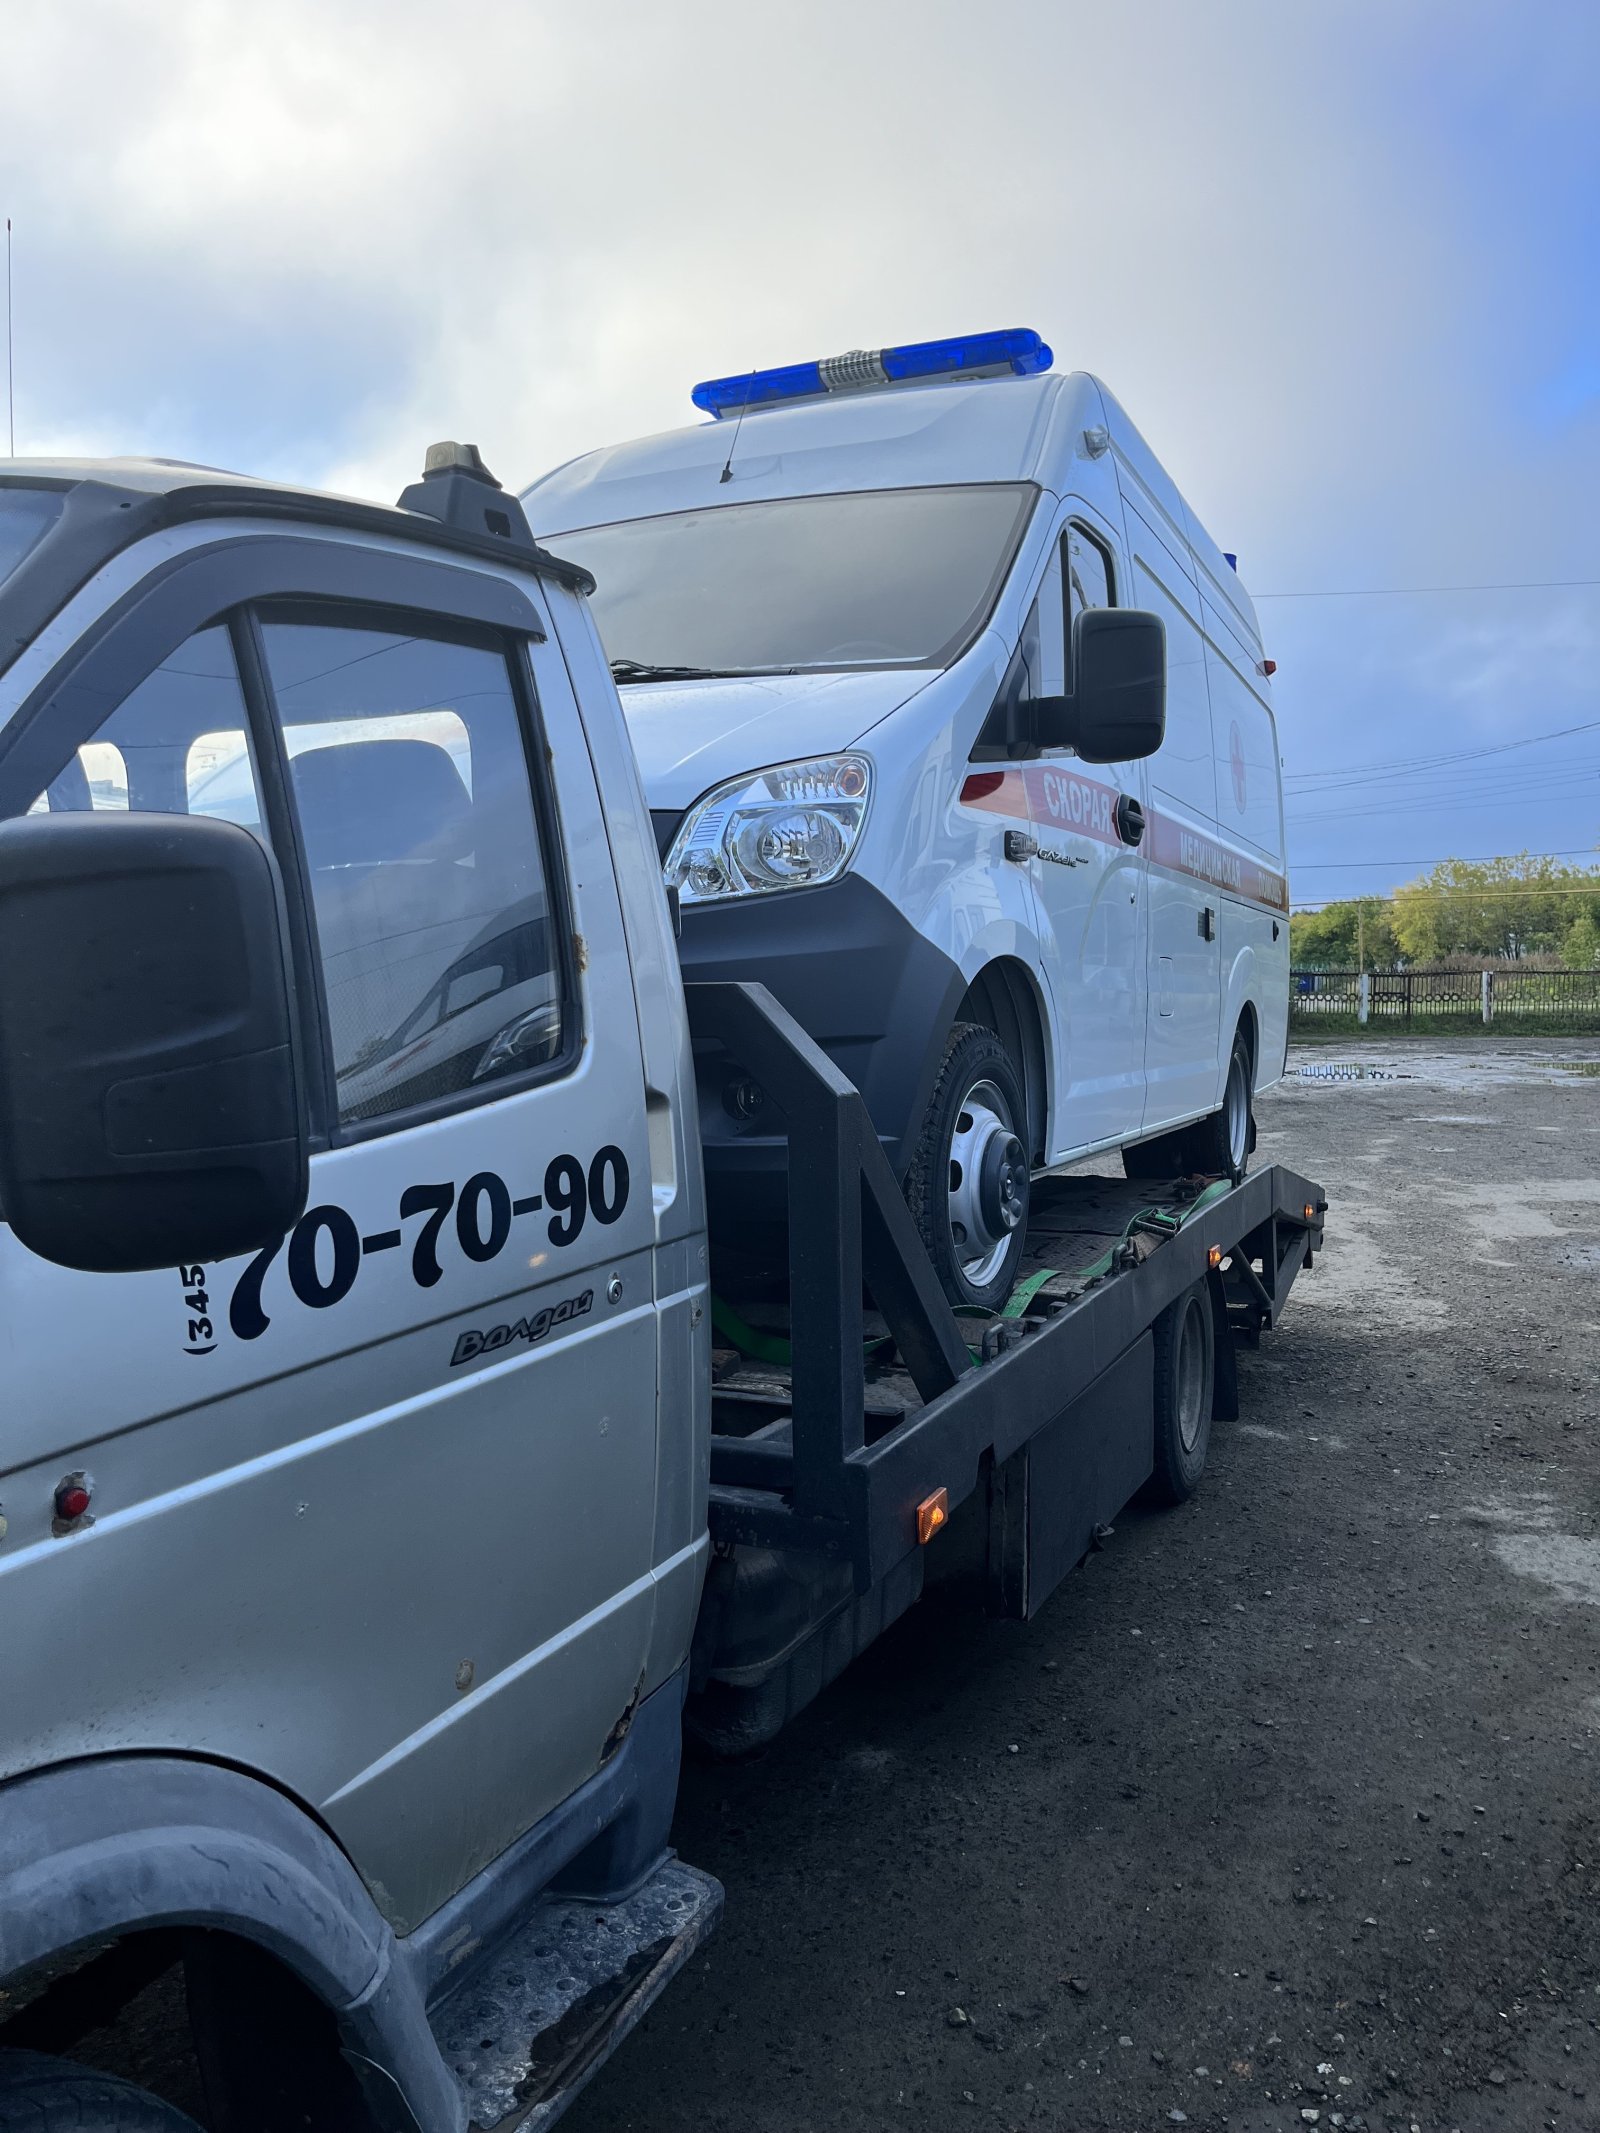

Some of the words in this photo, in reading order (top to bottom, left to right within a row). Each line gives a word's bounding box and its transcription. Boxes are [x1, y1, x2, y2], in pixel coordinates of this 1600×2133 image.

[1043, 772, 1111, 835] СКОРАЯ
[1180, 831, 1241, 888] МЕДИЦИНСКАЯ
[450, 1289, 594, 1367] Валдай
